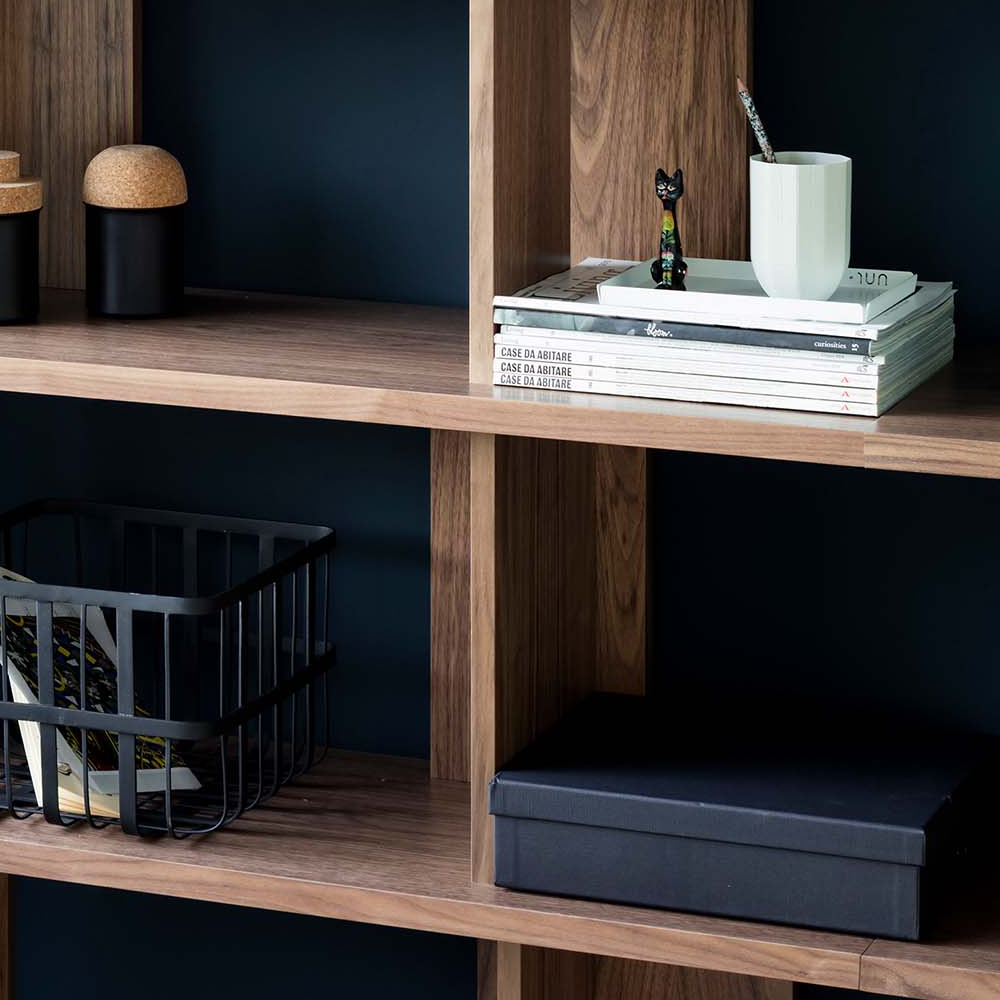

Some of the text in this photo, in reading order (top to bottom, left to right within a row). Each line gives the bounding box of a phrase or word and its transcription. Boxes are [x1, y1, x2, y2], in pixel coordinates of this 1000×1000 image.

[813, 341, 848, 350] curiosities
[501, 347, 573, 362] CASE DA ABITARE
[500, 361, 572, 377] CASE DA ABITARE
[500, 374, 572, 389] CASE DA ABITARE
